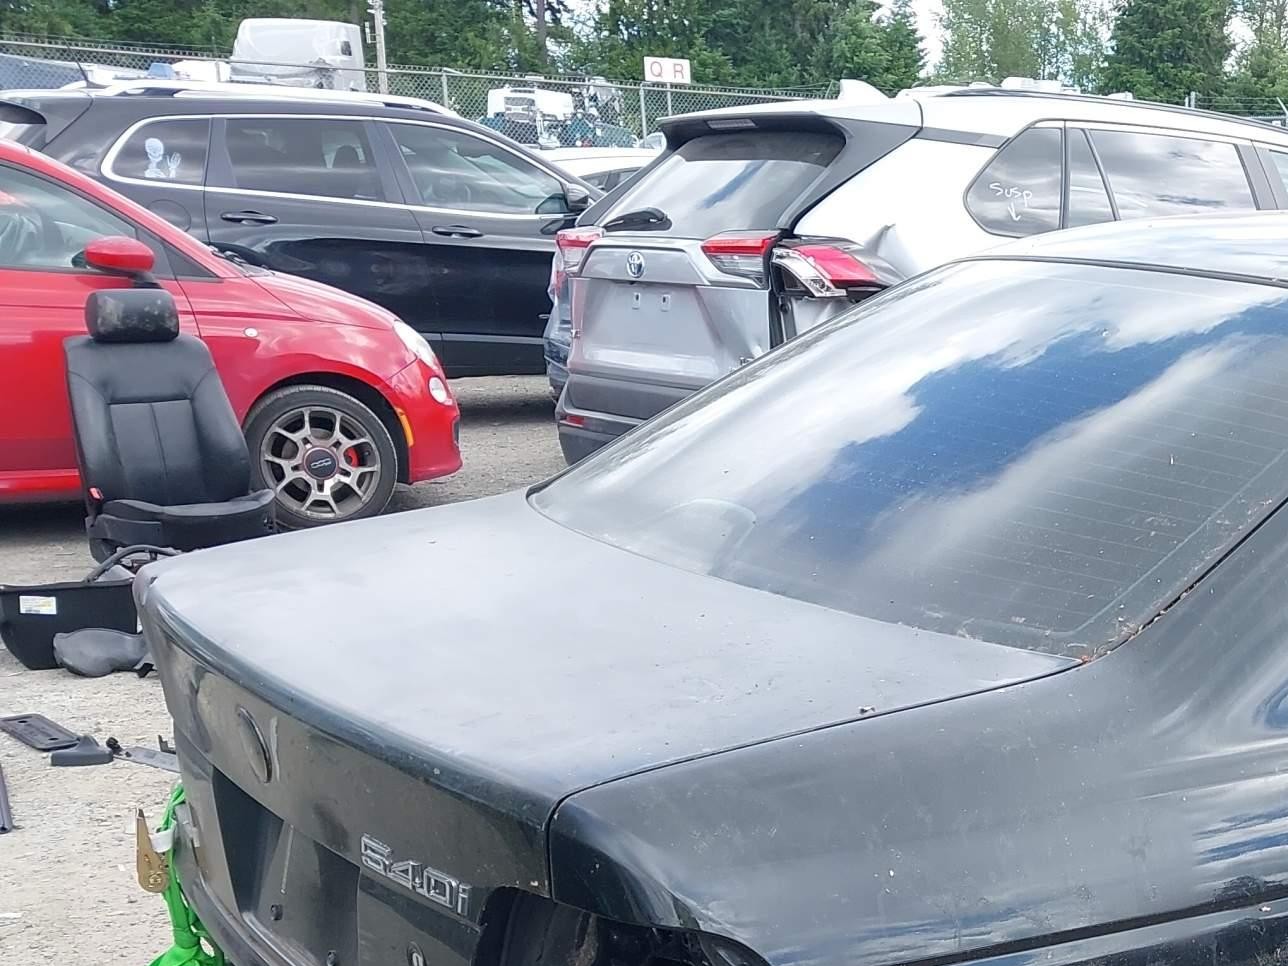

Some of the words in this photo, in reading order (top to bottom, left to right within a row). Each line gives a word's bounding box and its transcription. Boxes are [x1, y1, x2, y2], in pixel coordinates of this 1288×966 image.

[650, 60, 663, 78] Q
[673, 63, 685, 79] R
[360, 832, 474, 917] 540i
